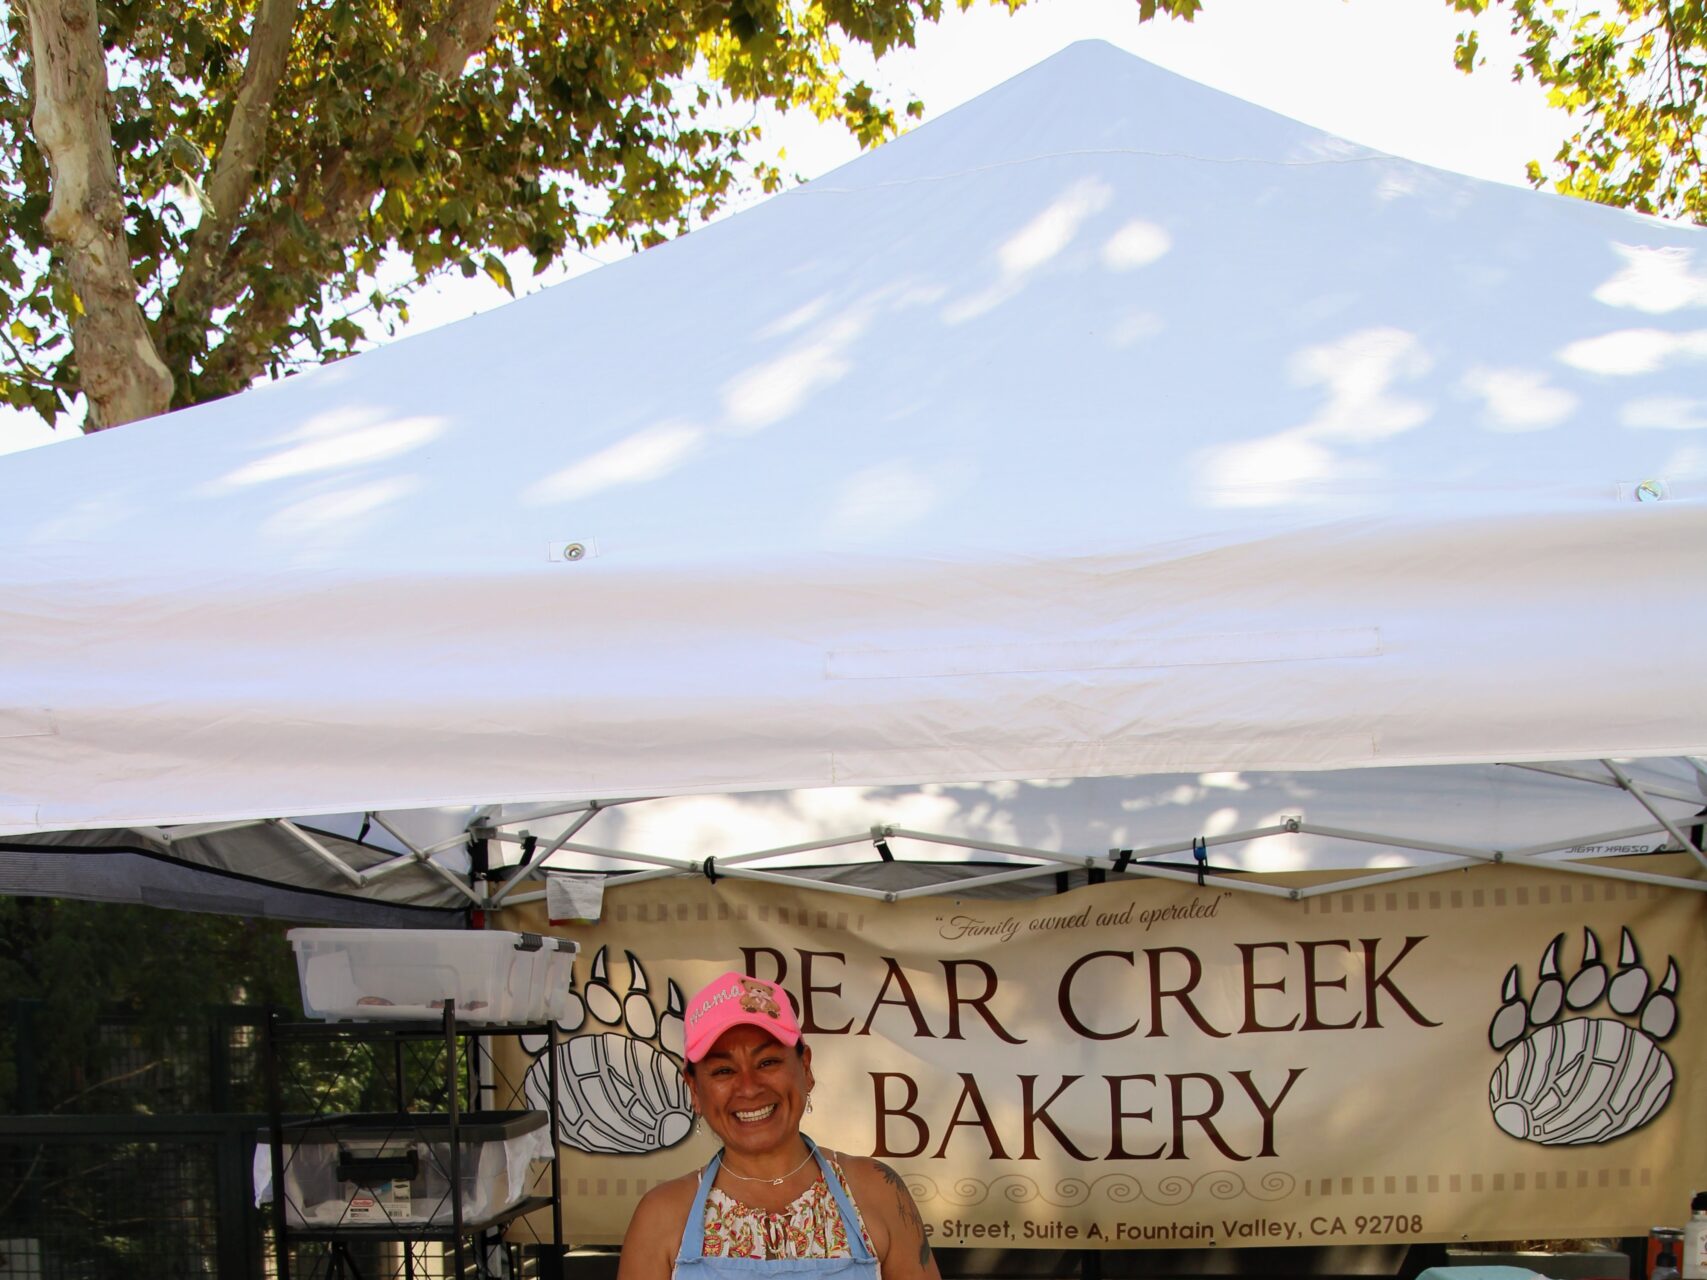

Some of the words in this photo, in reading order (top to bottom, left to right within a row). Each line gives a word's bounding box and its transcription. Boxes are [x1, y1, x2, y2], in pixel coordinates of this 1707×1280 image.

[1029, 905, 1092, 931] owned
[1096, 902, 1136, 927] and
[1057, 935, 1444, 1041] CREEK
[867, 1066, 1310, 1162] BAKERY
[942, 1219, 1016, 1241] Street,
[1023, 1220, 1079, 1239] Suite
[1087, 1222, 1109, 1242] A,
[1116, 1221, 1214, 1240] Fountain
[1222, 1218, 1302, 1240] Valley,
[1310, 1216, 1347, 1236] CA
[1354, 1214, 1423, 1235] 92708
